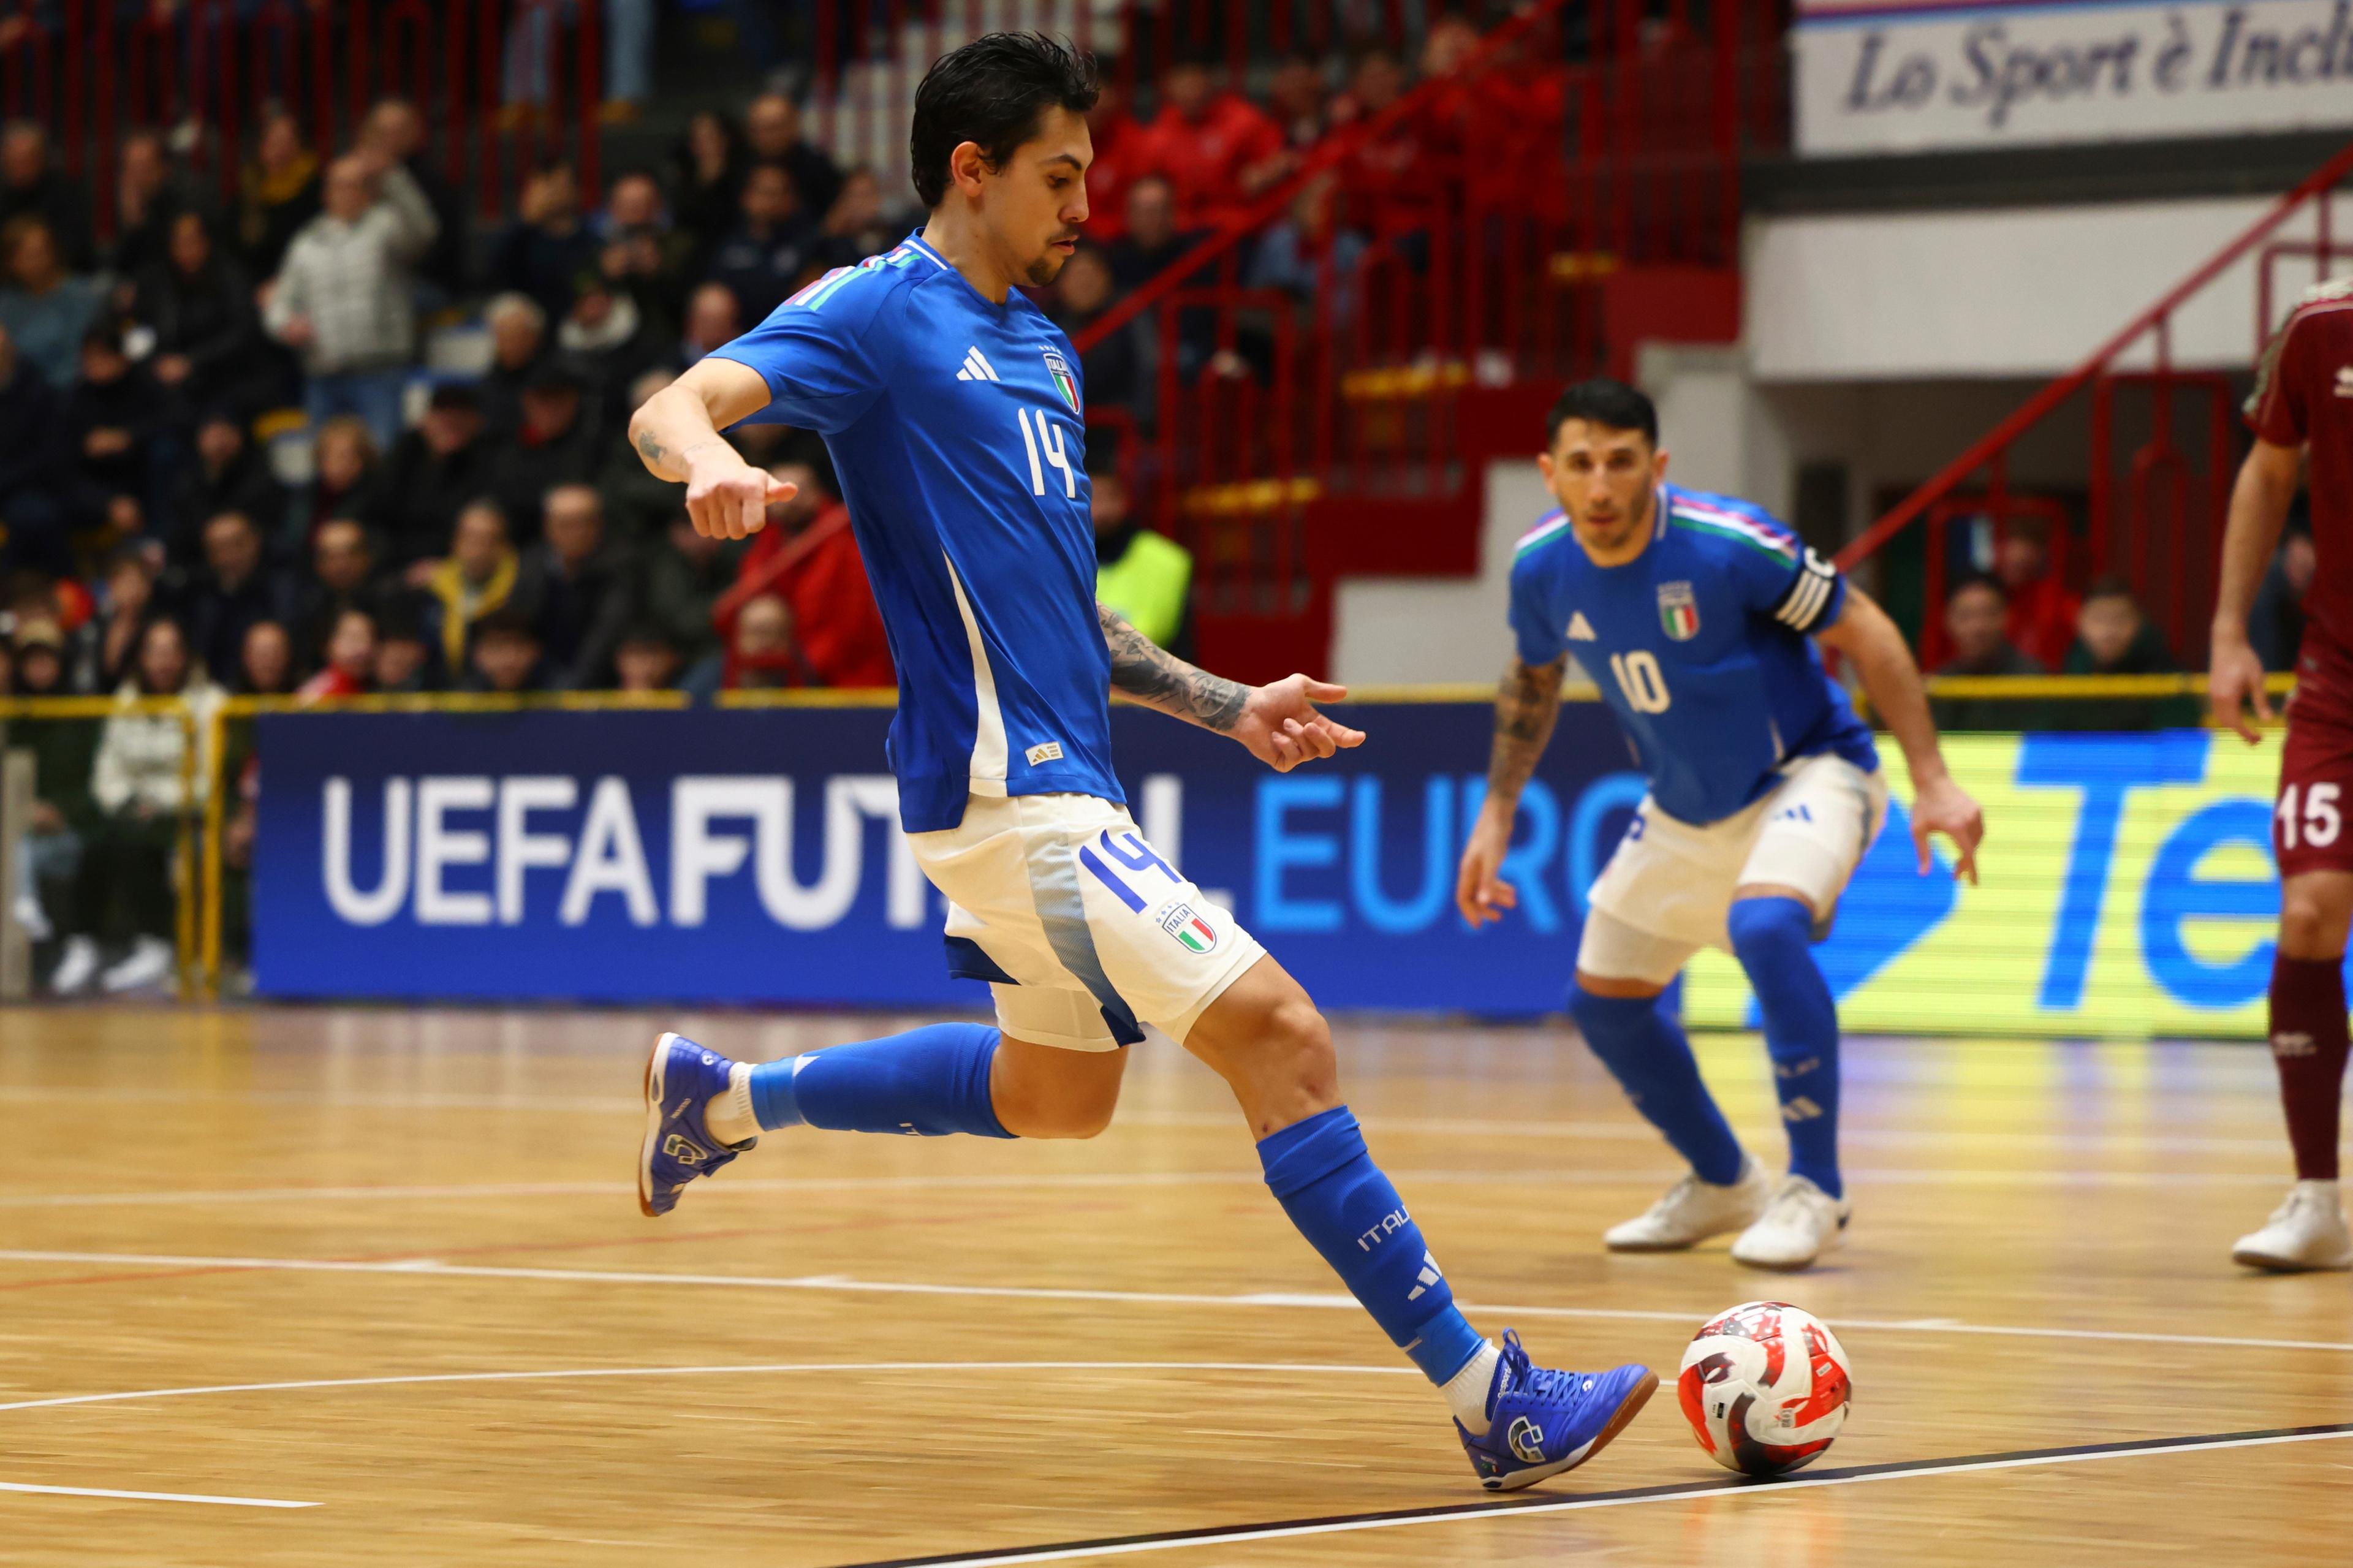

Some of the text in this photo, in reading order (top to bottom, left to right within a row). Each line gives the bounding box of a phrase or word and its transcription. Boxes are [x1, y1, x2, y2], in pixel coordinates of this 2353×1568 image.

[1847, 32, 1938, 112] Lo
[1951, 20, 2139, 126] Sport
[1018, 407, 1075, 498] 14
[1610, 650, 1670, 714] 10
[321, 776, 659, 926] UEFA
[2277, 782, 2342, 850] 15
[1079, 829, 1182, 914] 14
[1166, 909, 1191, 932] ITALIA
